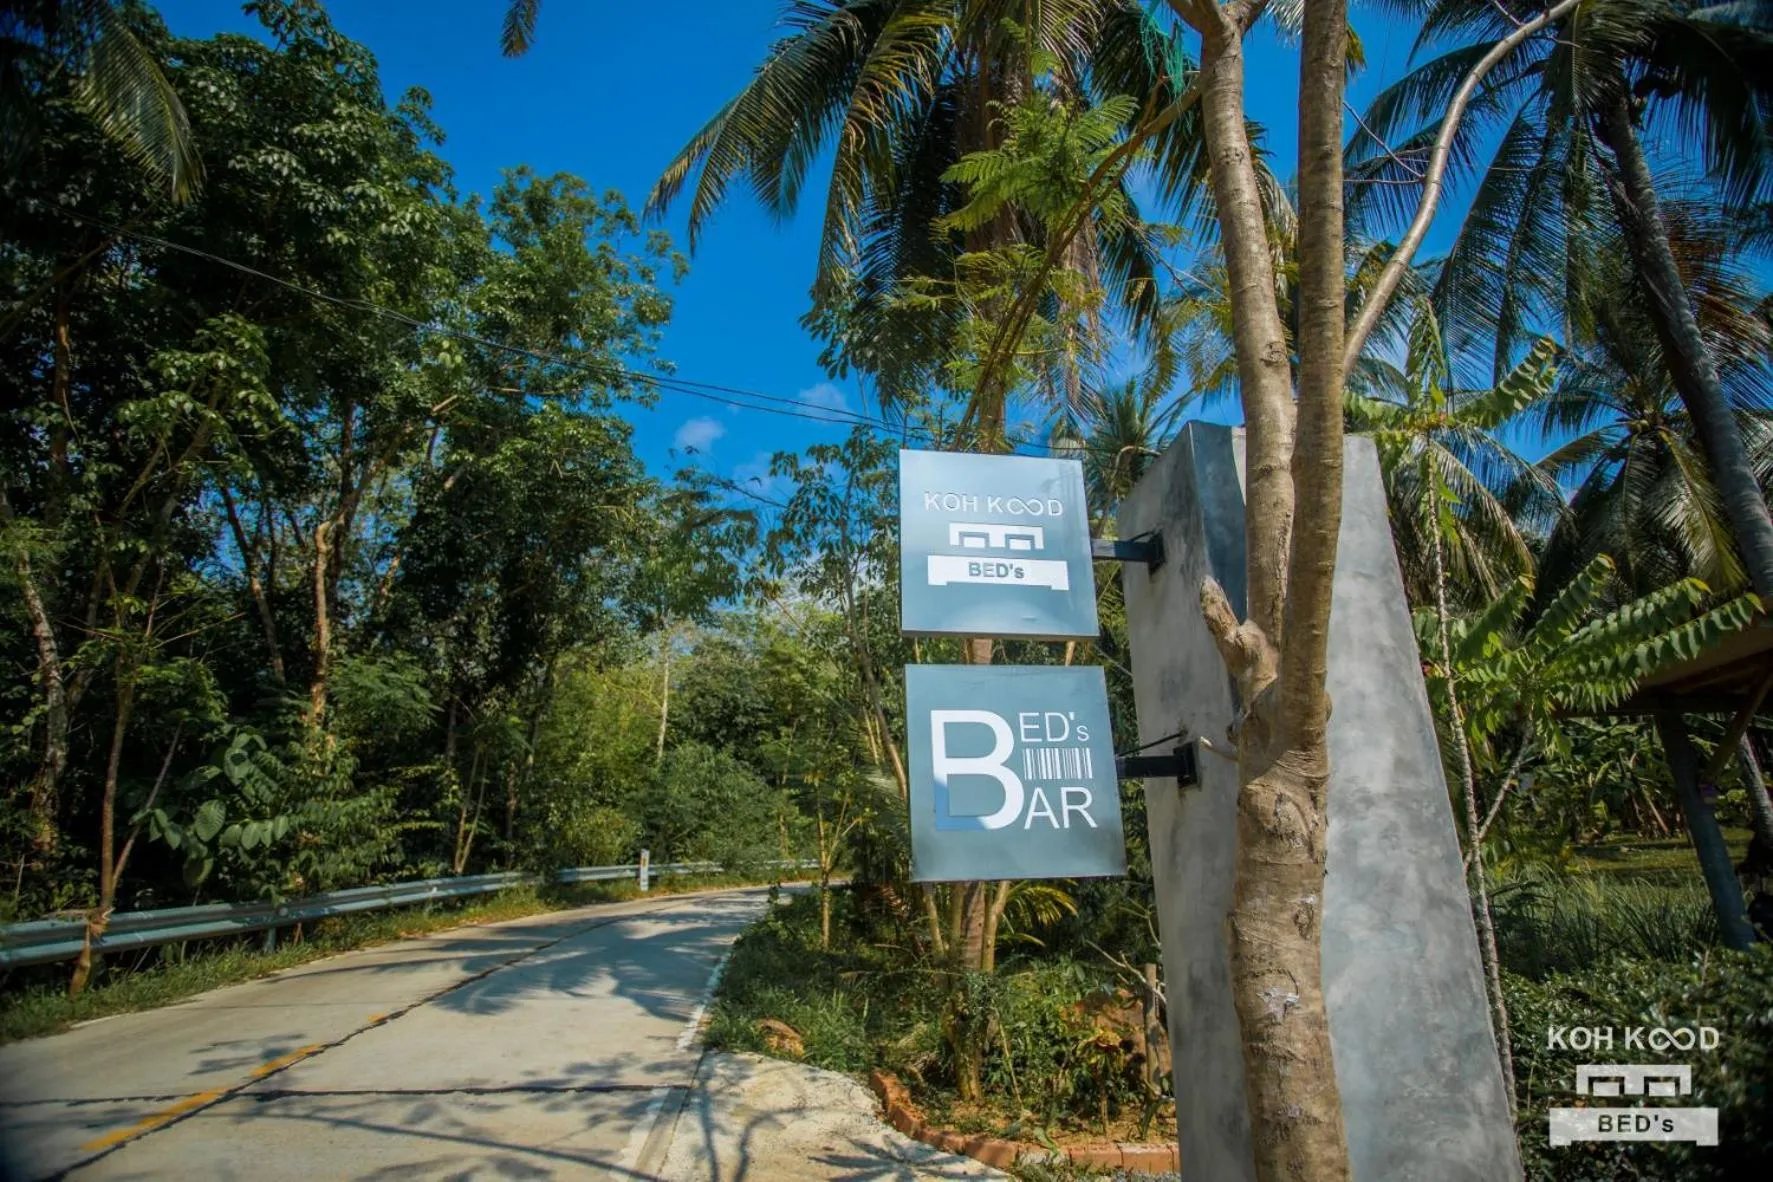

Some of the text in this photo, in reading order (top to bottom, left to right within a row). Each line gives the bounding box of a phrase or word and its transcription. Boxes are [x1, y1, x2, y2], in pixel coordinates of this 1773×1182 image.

[924, 491, 1064, 517] KOH KOOD
[968, 562, 1025, 579] BED's
